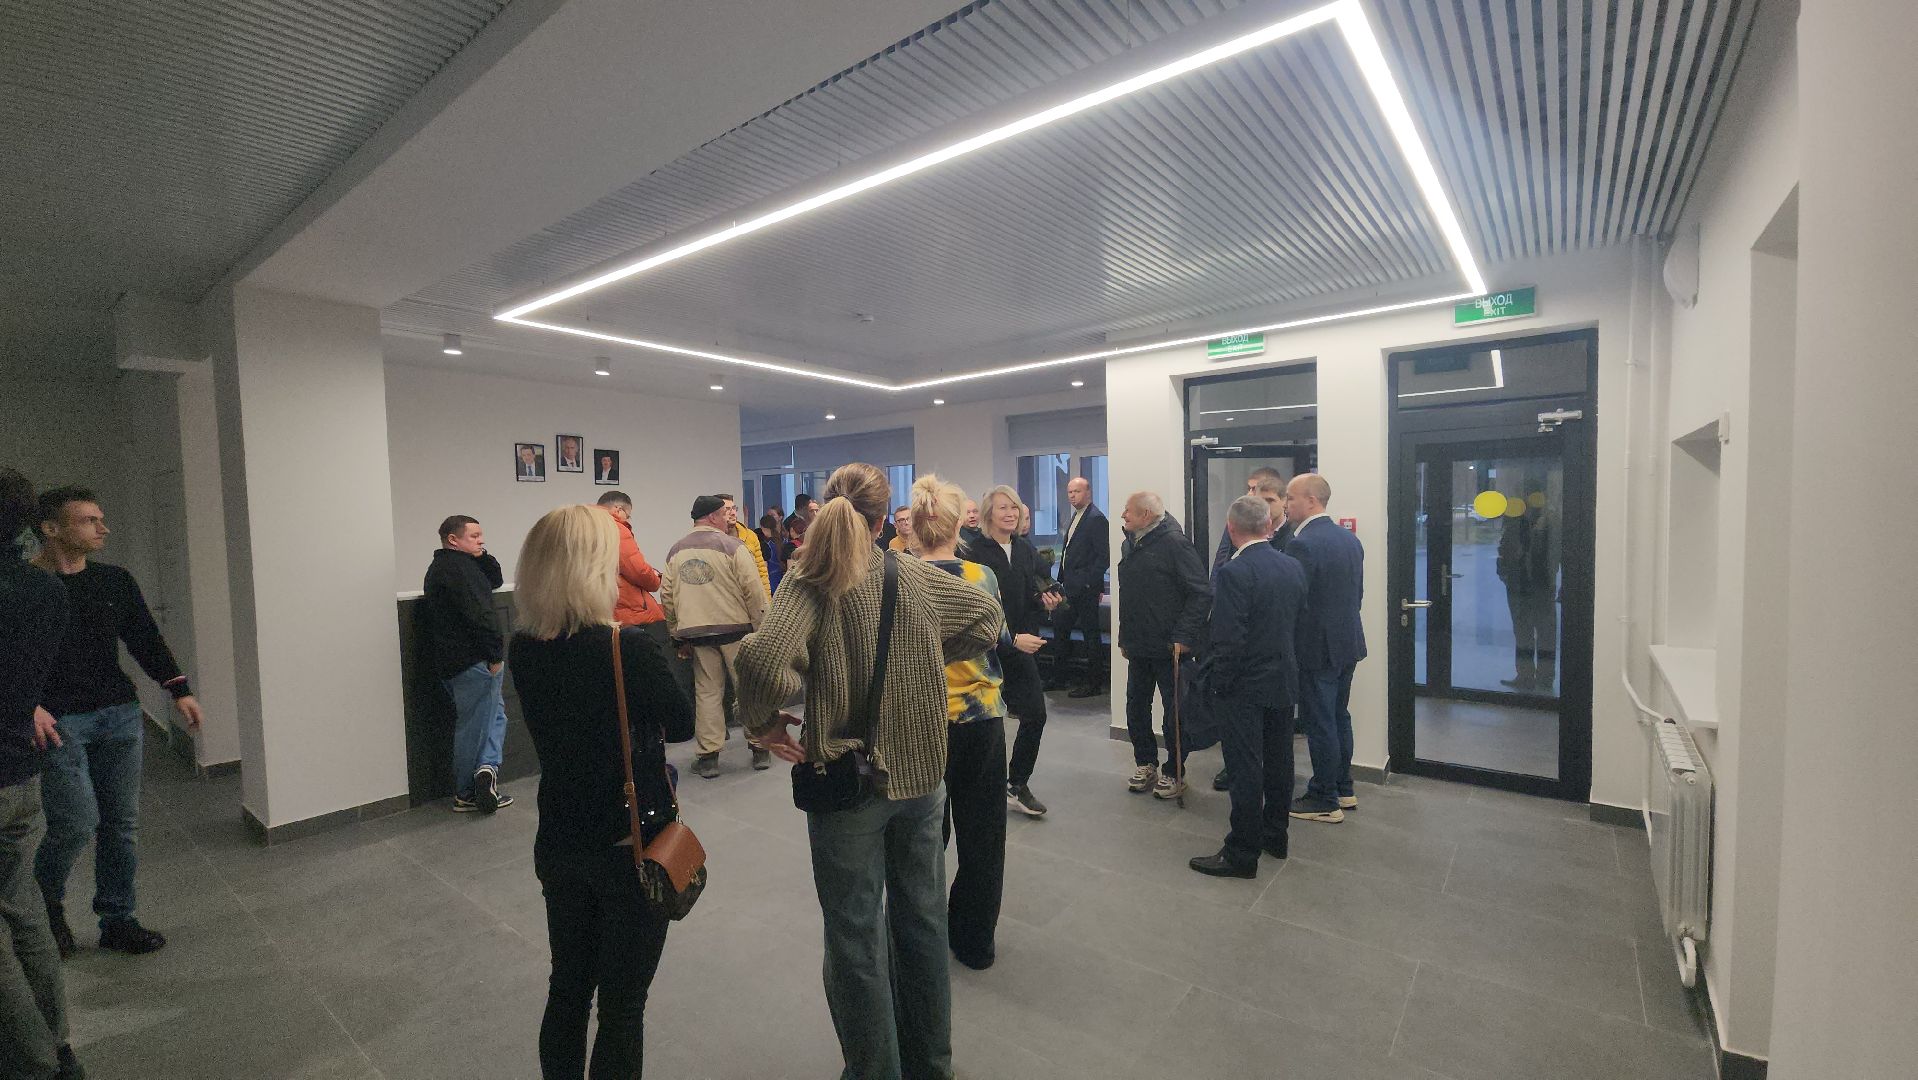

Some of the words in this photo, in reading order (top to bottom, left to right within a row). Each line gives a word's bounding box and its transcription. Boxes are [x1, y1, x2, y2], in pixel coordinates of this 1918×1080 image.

[1475, 294, 1513, 309] ВЫХОД
[1484, 306, 1507, 317] EXIT
[1221, 333, 1249, 345] ВЫХОД
